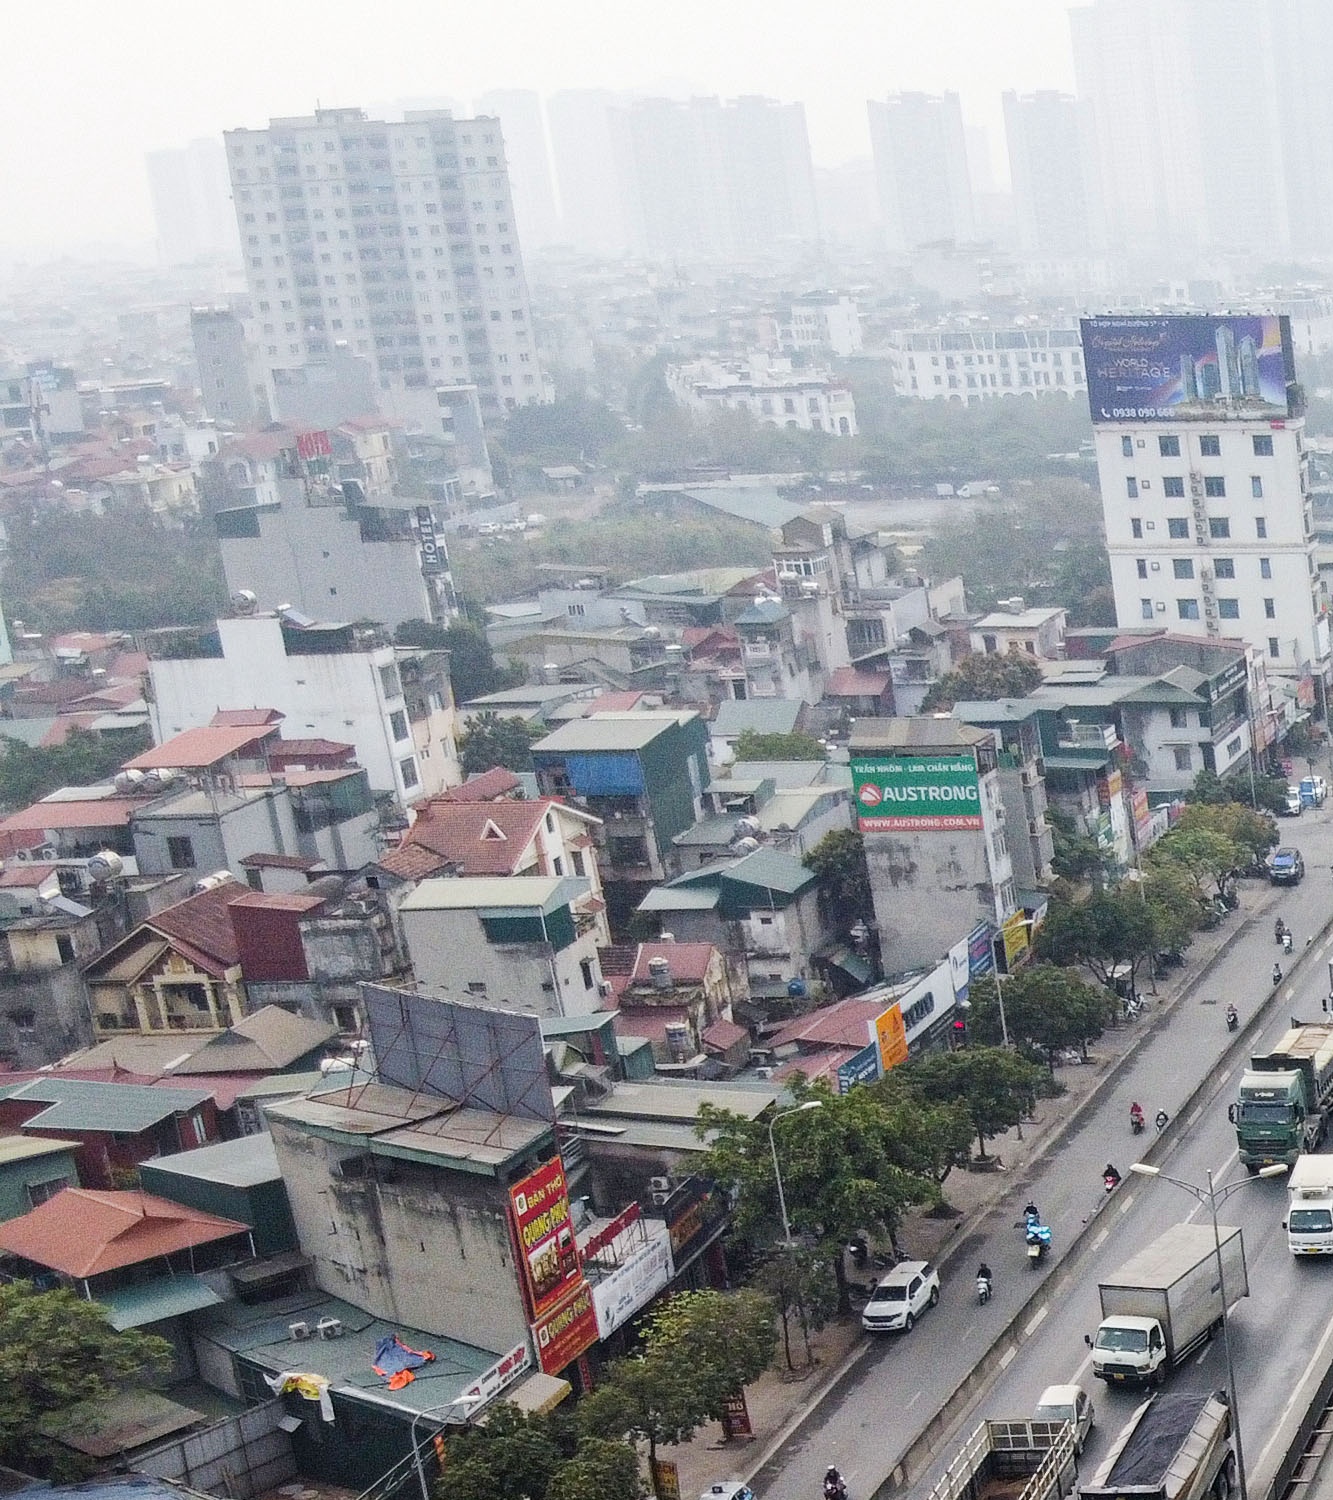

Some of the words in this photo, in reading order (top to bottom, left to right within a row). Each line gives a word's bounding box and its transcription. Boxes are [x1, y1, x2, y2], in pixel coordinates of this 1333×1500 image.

[1113, 358, 1149, 368] WORLD
[1098, 367, 1171, 378] HERITAGE
[419, 517, 438, 563] HOTEL
[883, 785, 977, 802] AUSTRONG
[863, 818, 980, 828] WWW.AUSTRONG.COM.VN
